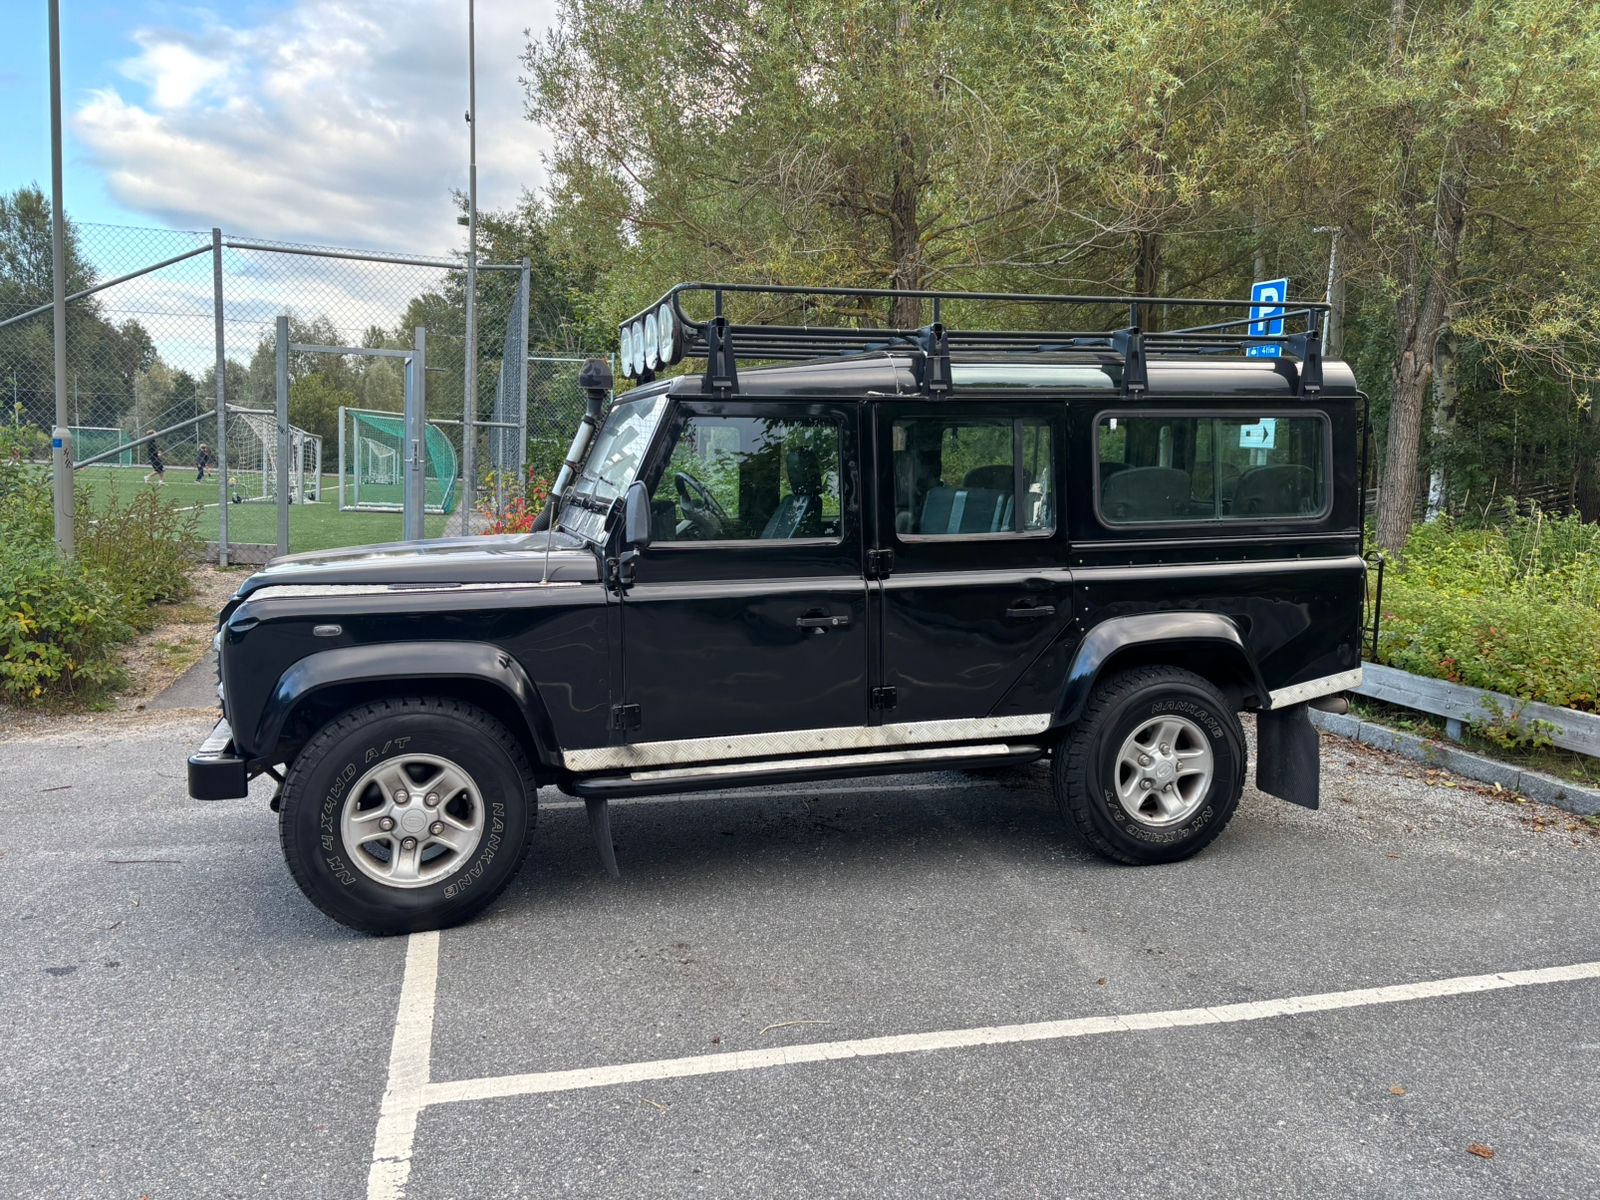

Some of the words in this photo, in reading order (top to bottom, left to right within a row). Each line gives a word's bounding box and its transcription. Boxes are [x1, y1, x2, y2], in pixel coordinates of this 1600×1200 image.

[1258, 287, 1279, 332] P
[1151, 700, 1224, 739] NANKANG
[326, 856, 356, 886] NK
[365, 736, 411, 763] A/T
[1104, 789, 1125, 821] A/T
[1193, 805, 1214, 832] NK
[443, 802, 505, 899] NANKANG
